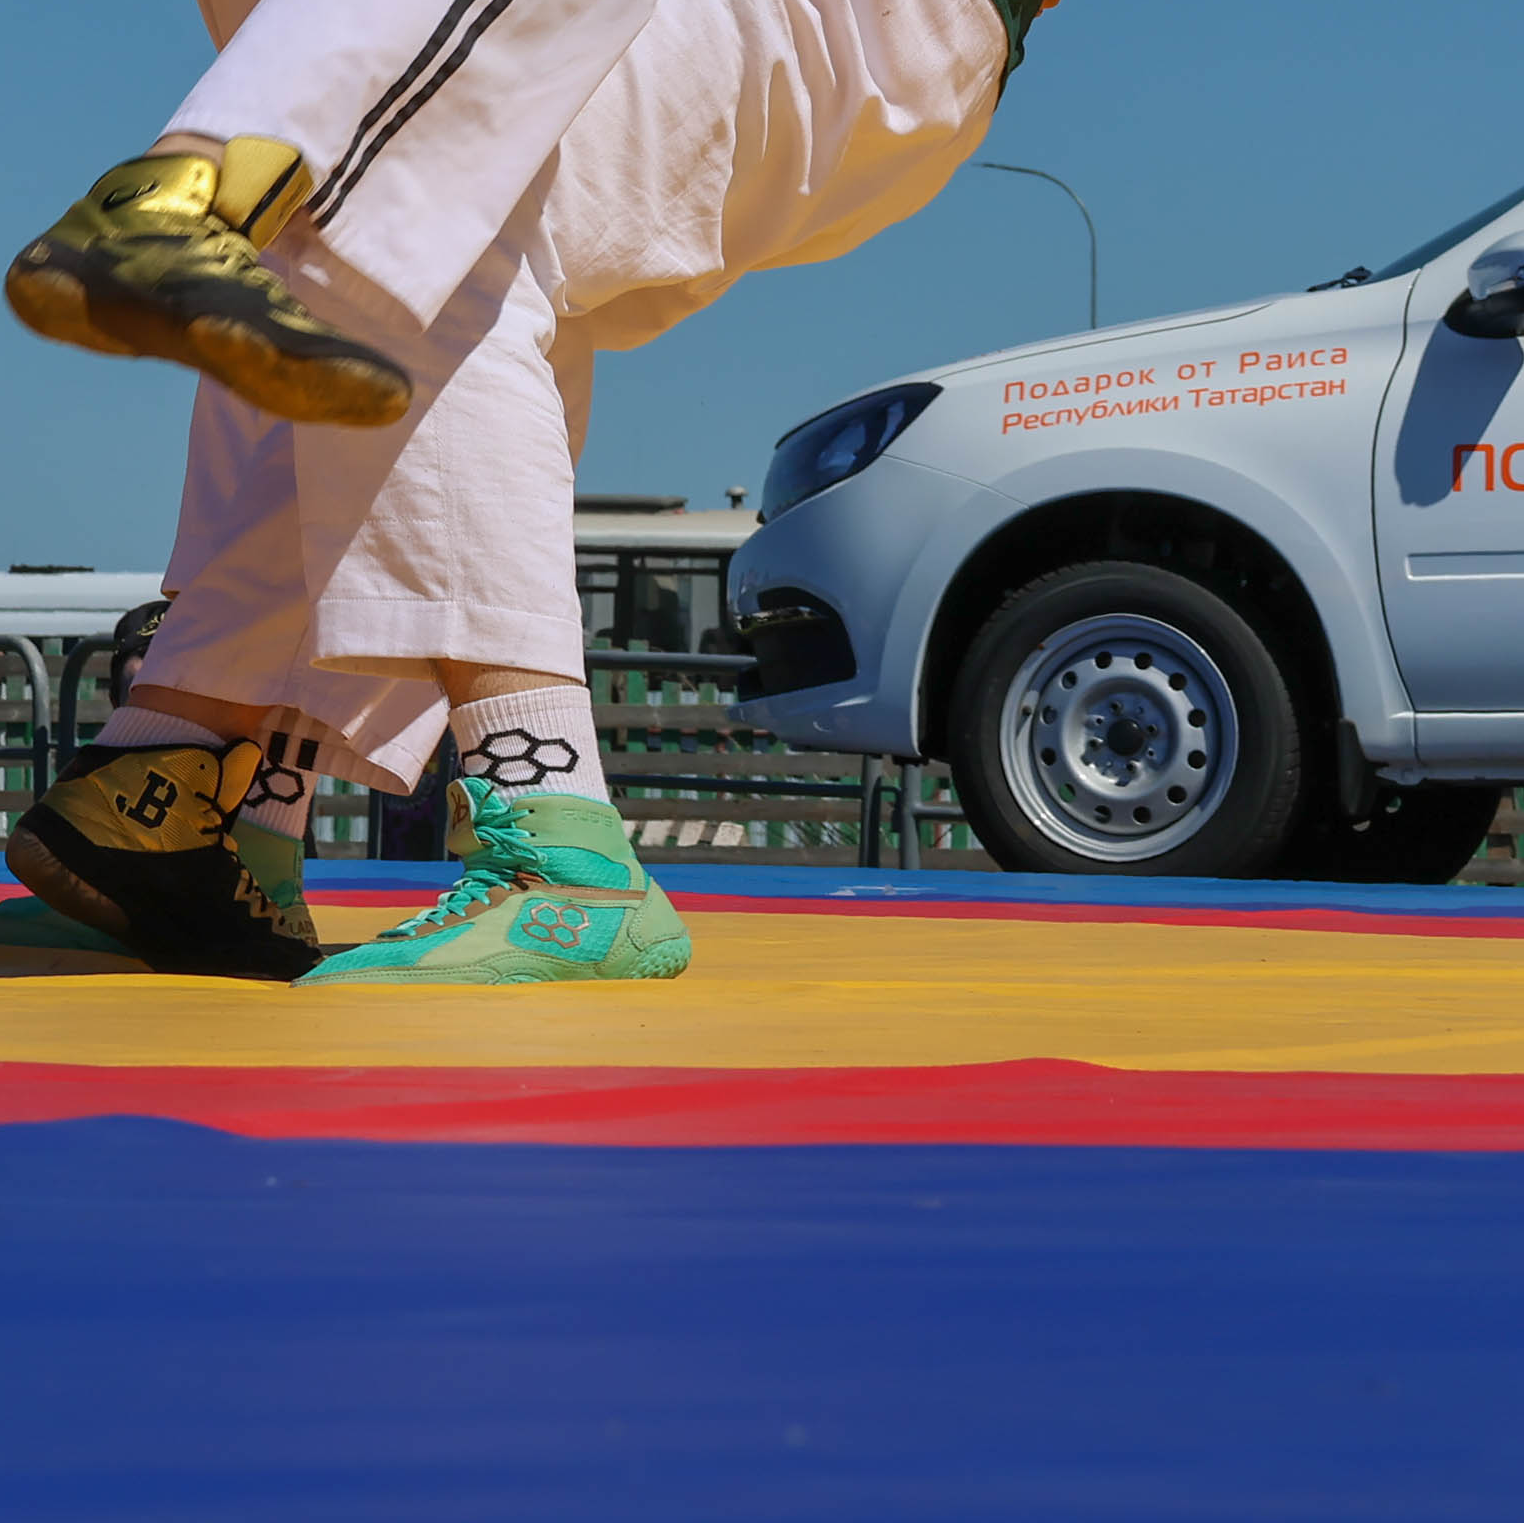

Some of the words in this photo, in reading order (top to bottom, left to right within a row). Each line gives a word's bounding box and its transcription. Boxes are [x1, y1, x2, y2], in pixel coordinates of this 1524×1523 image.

[1004, 367, 1156, 404] Подарок
[1176, 360, 1218, 381] от
[1238, 347, 1349, 375] Раиса
[1001, 393, 1180, 435] Республики
[1188, 377, 1347, 409] Татарстан
